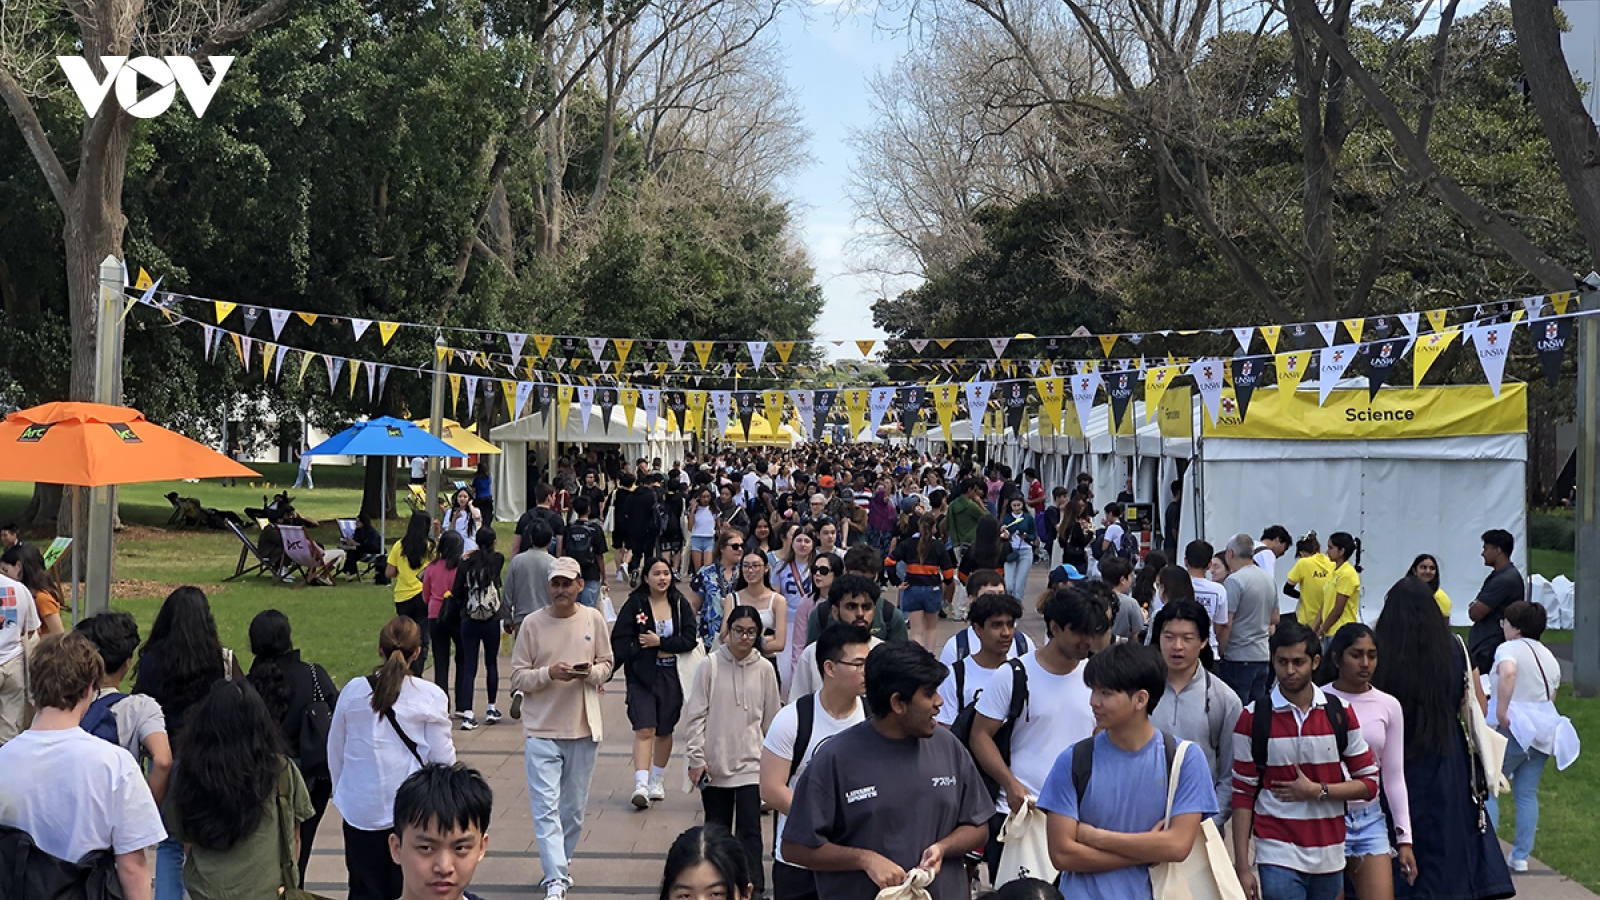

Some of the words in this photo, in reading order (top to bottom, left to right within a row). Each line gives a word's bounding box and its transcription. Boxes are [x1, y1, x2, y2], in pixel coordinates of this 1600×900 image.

[1537, 338, 1565, 351] UNSW
[1480, 348, 1505, 358] UNSW
[1370, 357, 1396, 366] UNSW
[1321, 364, 1345, 372] UNSW
[1234, 375, 1256, 384] UNSW
[1279, 371, 1300, 379] UNSW
[1200, 381, 1220, 391] UNSW
[1345, 407, 1415, 421] Science
[1216, 416, 1243, 425] NSW
[22, 427, 46, 438] Arc
[286, 539, 303, 550] Arc
